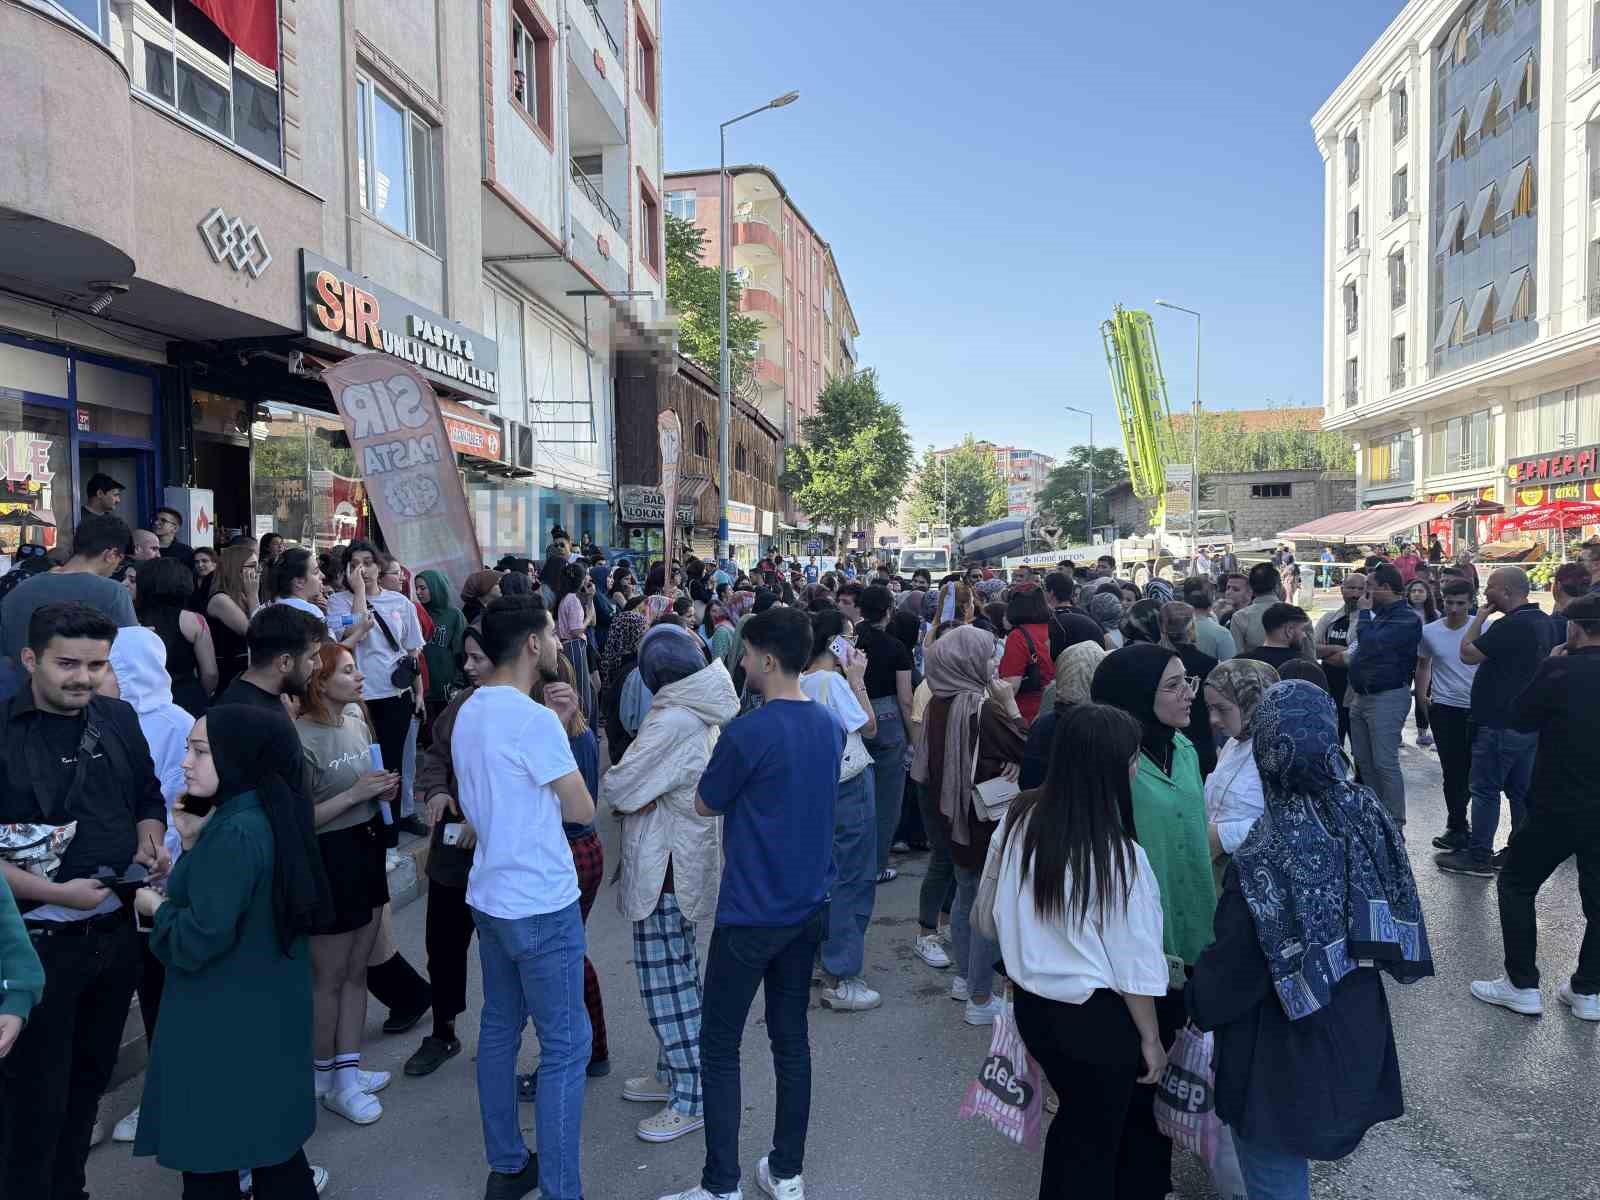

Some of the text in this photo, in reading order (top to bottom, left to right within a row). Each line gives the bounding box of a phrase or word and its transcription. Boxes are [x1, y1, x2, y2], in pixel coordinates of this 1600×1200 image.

[316, 270, 383, 350] SIR
[382, 329, 423, 364] UNLU
[412, 315, 463, 355] PASTA
[0, 433, 55, 483] LE
[629, 506, 689, 520] LOKANSI
